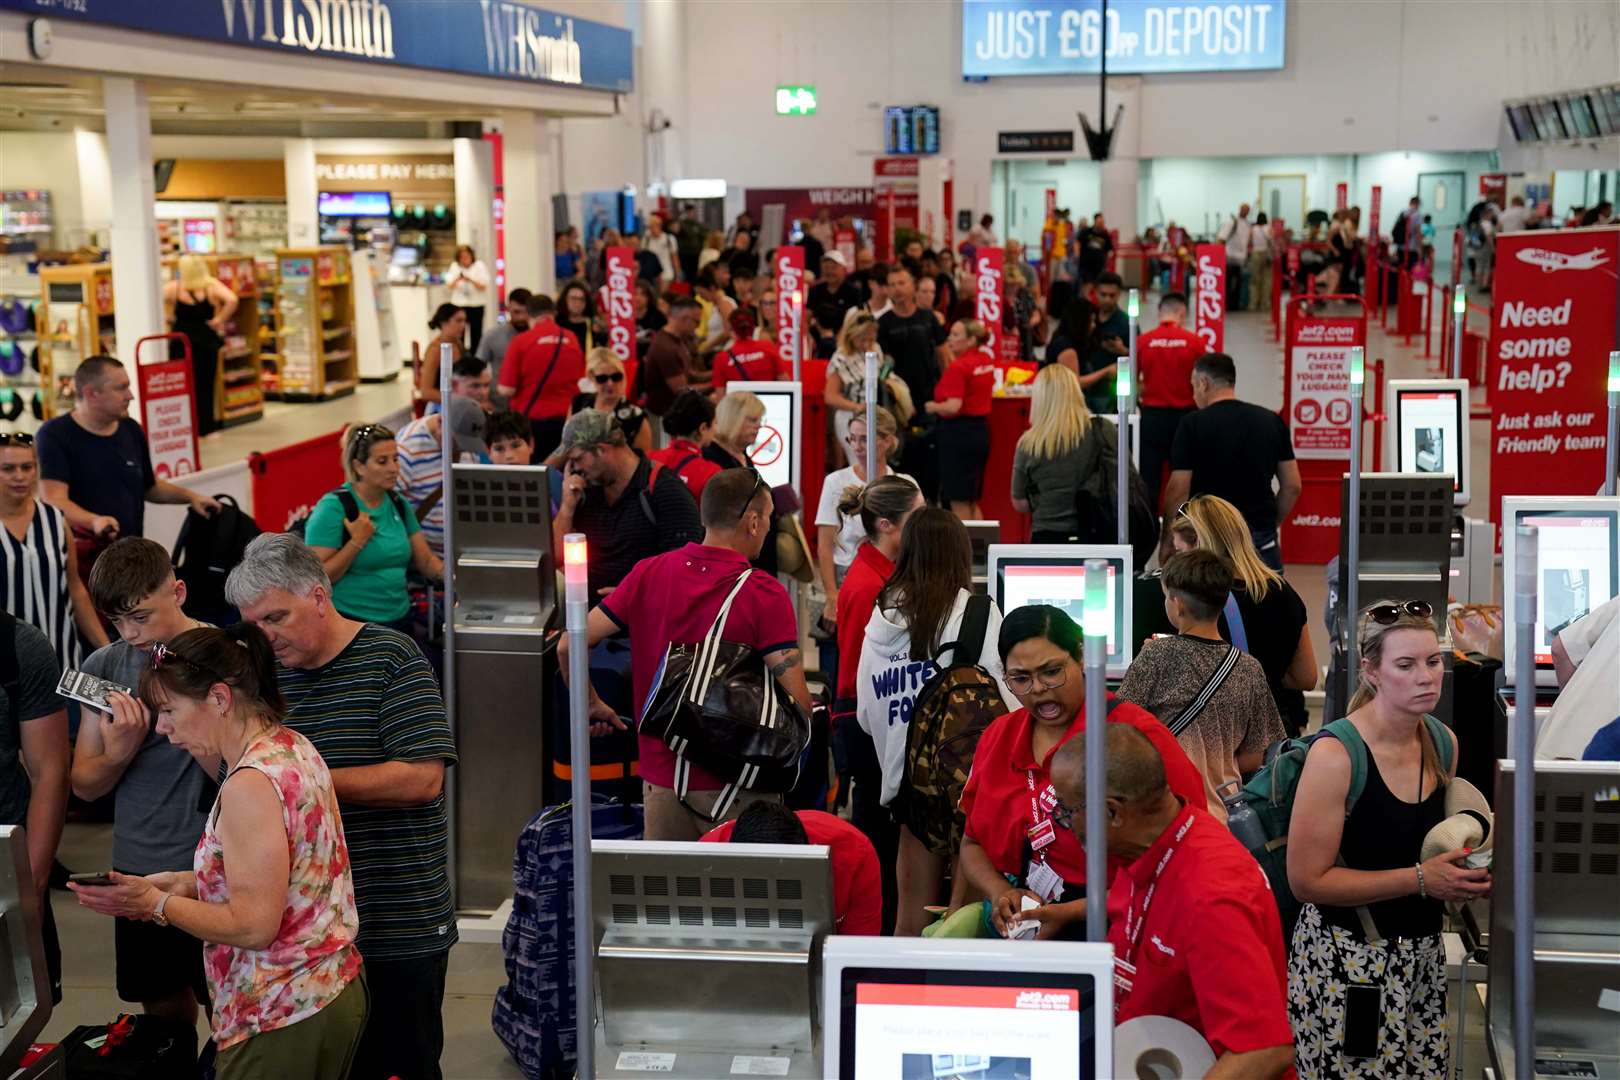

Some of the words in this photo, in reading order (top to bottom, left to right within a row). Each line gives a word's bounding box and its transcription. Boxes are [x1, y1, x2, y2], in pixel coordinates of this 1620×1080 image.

[479, 1, 582, 84] WHSmith
[976, 10, 1051, 60] JUST
[1144, 5, 1272, 56] DEPOSIT
[316, 164, 378, 179] PLEASE
[380, 164, 412, 178] PAY
[809, 189, 864, 205] WEIGH
[1500, 299, 1572, 328] Need
[1306, 352, 1345, 360] PLEASE
[1498, 336, 1571, 360] some
[1297, 372, 1324, 380] YOUR
[1308, 362, 1343, 370] CHECK
[1301, 383, 1349, 391] LUGGAGE
[1498, 361, 1572, 394] help?
[1496, 412, 1530, 431] Just
[1534, 411, 1563, 429] ask
[1566, 412, 1594, 427] our
[1496, 435, 1560, 455] Friendly
[1564, 435, 1605, 450] team
[889, 653, 907, 663] VOL.3
[872, 660, 937, 700] WHITE
[888, 694, 917, 726] FO
[1016, 991, 1070, 1003] Jet2.com
